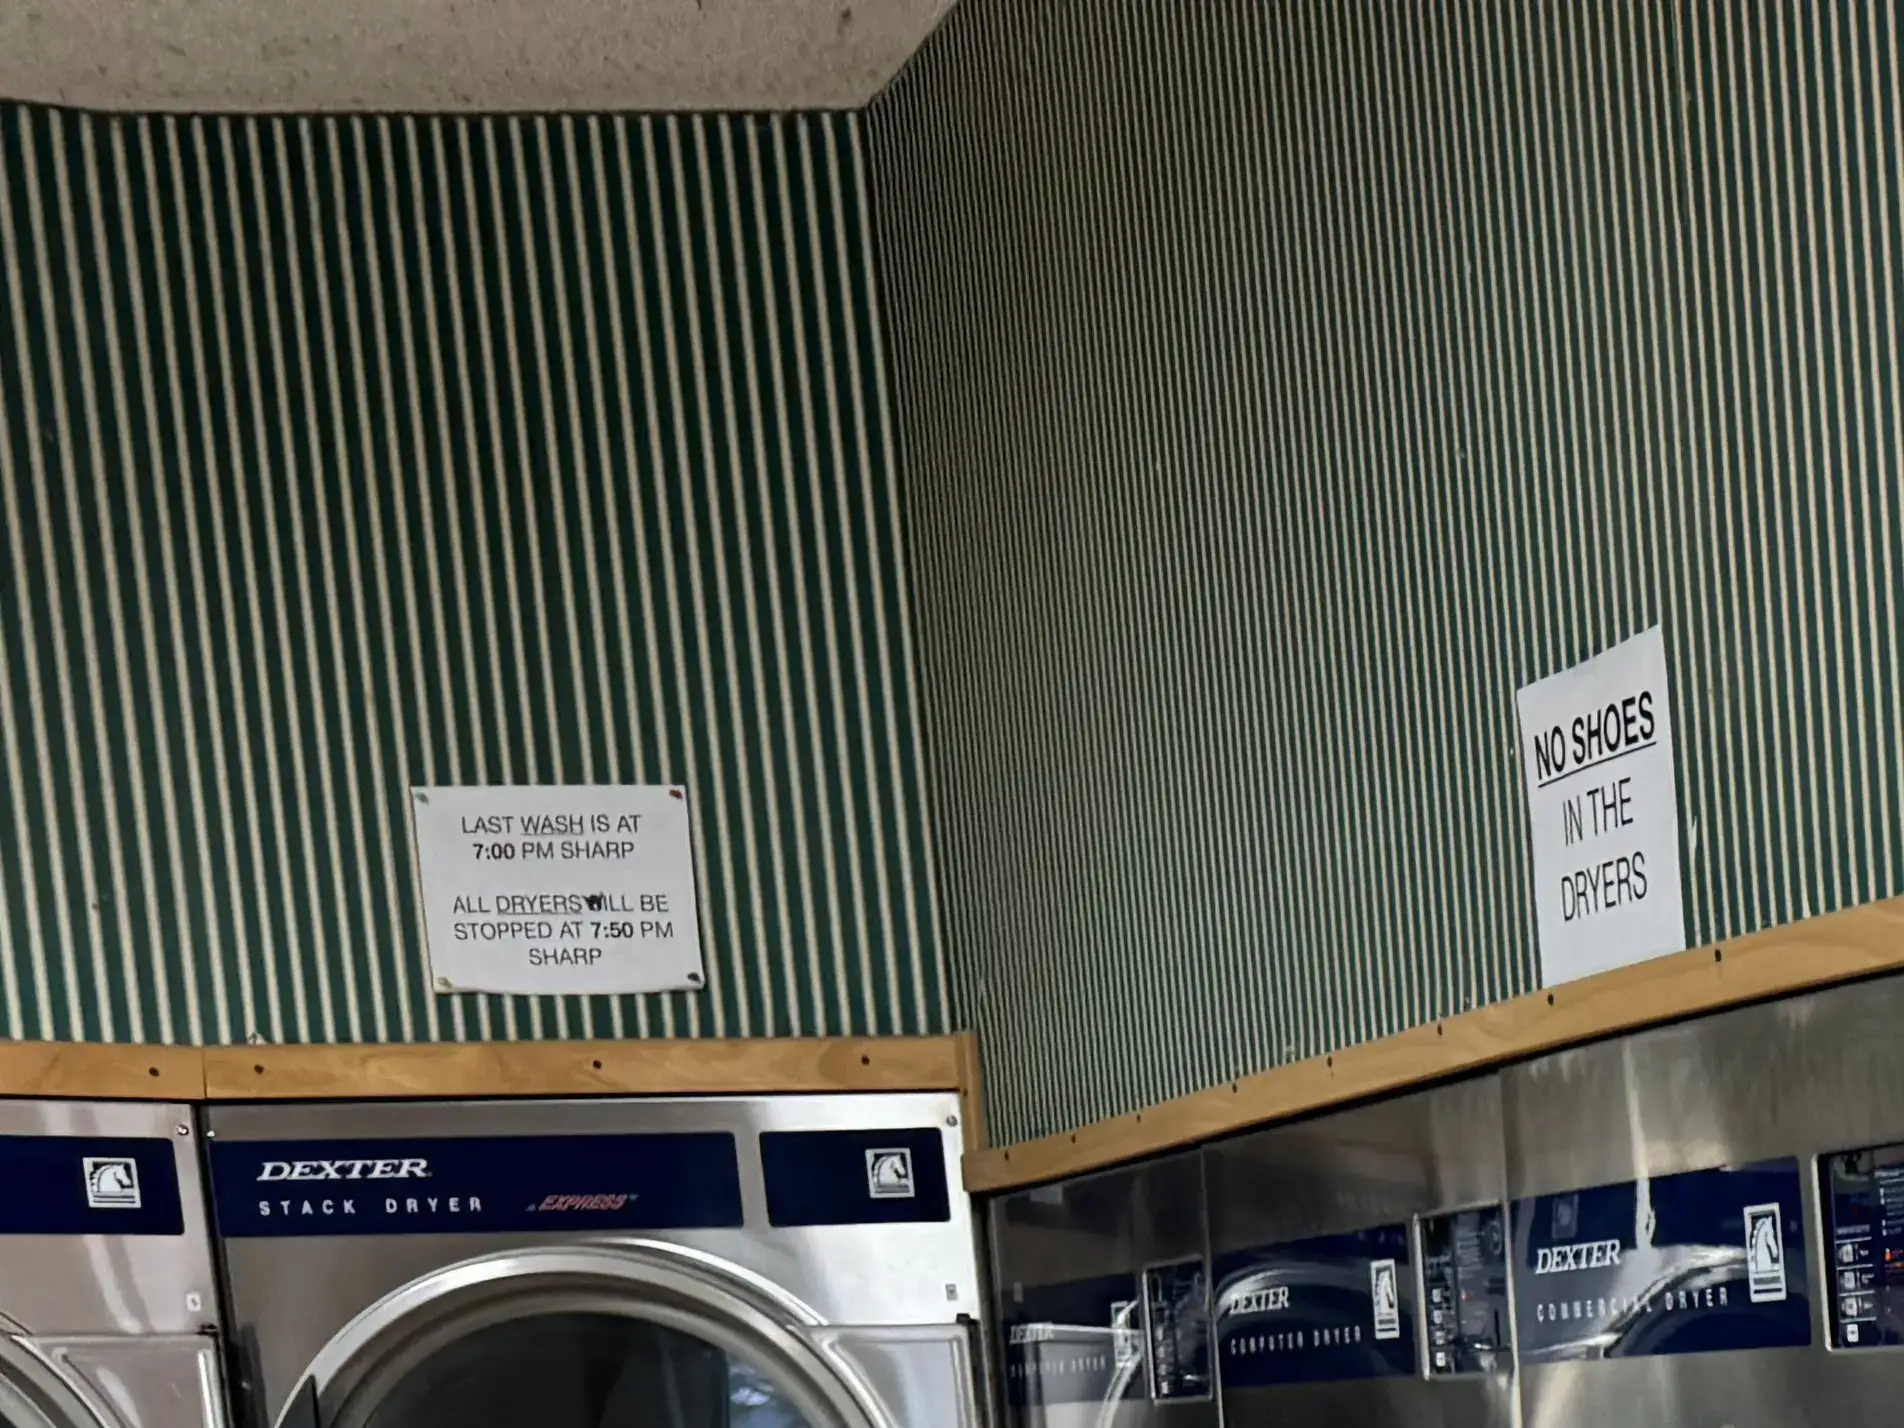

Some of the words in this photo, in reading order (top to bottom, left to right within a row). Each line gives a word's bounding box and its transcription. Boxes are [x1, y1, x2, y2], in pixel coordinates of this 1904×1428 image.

[1534, 725, 1566, 781] NO
[1571, 690, 1656, 766] SHOES
[461, 816, 515, 835] LAST
[520, 815, 584, 835] WASH
[590, 814, 611, 833] IS
[616, 814, 642, 833] AT
[1562, 794, 1584, 847] IN
[1586, 777, 1635, 837] THE
[472, 842, 516, 861] 7:00
[521, 841, 555, 860] PM
[560, 841, 635, 860] SHARP
[1561, 851, 1649, 922] DRYERS
[453, 895, 491, 914] ALL
[496, 895, 583, 914] DRYERS
[640, 895, 670, 913] BE
[453, 922, 552, 941] STOPPED
[559, 921, 585, 940] AT
[590, 921, 635, 940] 7:50
[640, 921, 675, 940] PM
[529, 948, 603, 967] SHARP
[255, 1157, 430, 1182] DEXTER
[258, 1198, 357, 1217] STACK
[385, 1195, 482, 1215] DRYER
[1534, 1239, 1622, 1276] DEXTER
[1229, 1285, 1290, 1316] DEXTER
[1664, 1286, 1730, 1313] DRYER
